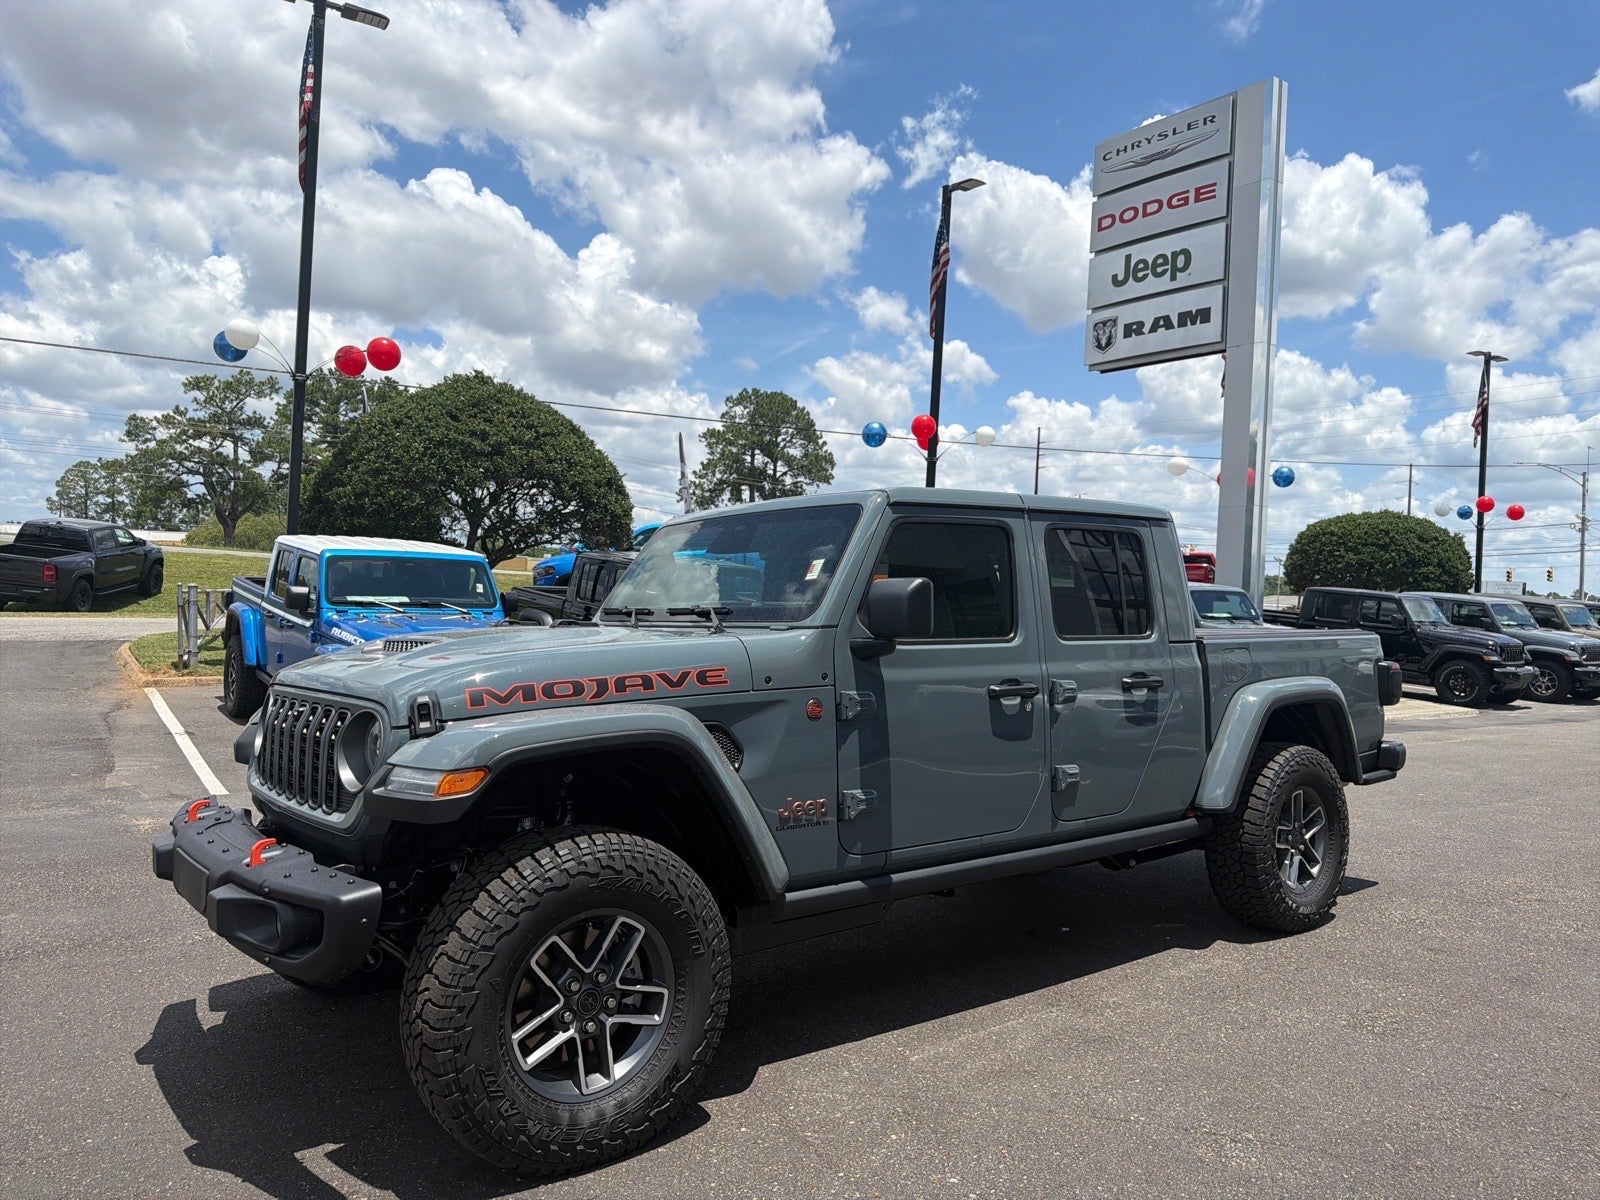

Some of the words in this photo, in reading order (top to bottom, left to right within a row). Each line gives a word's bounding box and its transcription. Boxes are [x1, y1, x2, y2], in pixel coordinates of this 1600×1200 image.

[1102, 114, 1217, 162] CHRYSLER
[1097, 182, 1217, 232] DODGE
[1111, 247, 1192, 288] Jeep
[1123, 306, 1212, 339] RAM
[331, 627, 366, 645] RUBICO
[465, 667, 730, 709] MOJAVE
[778, 797, 828, 819] Jeep
